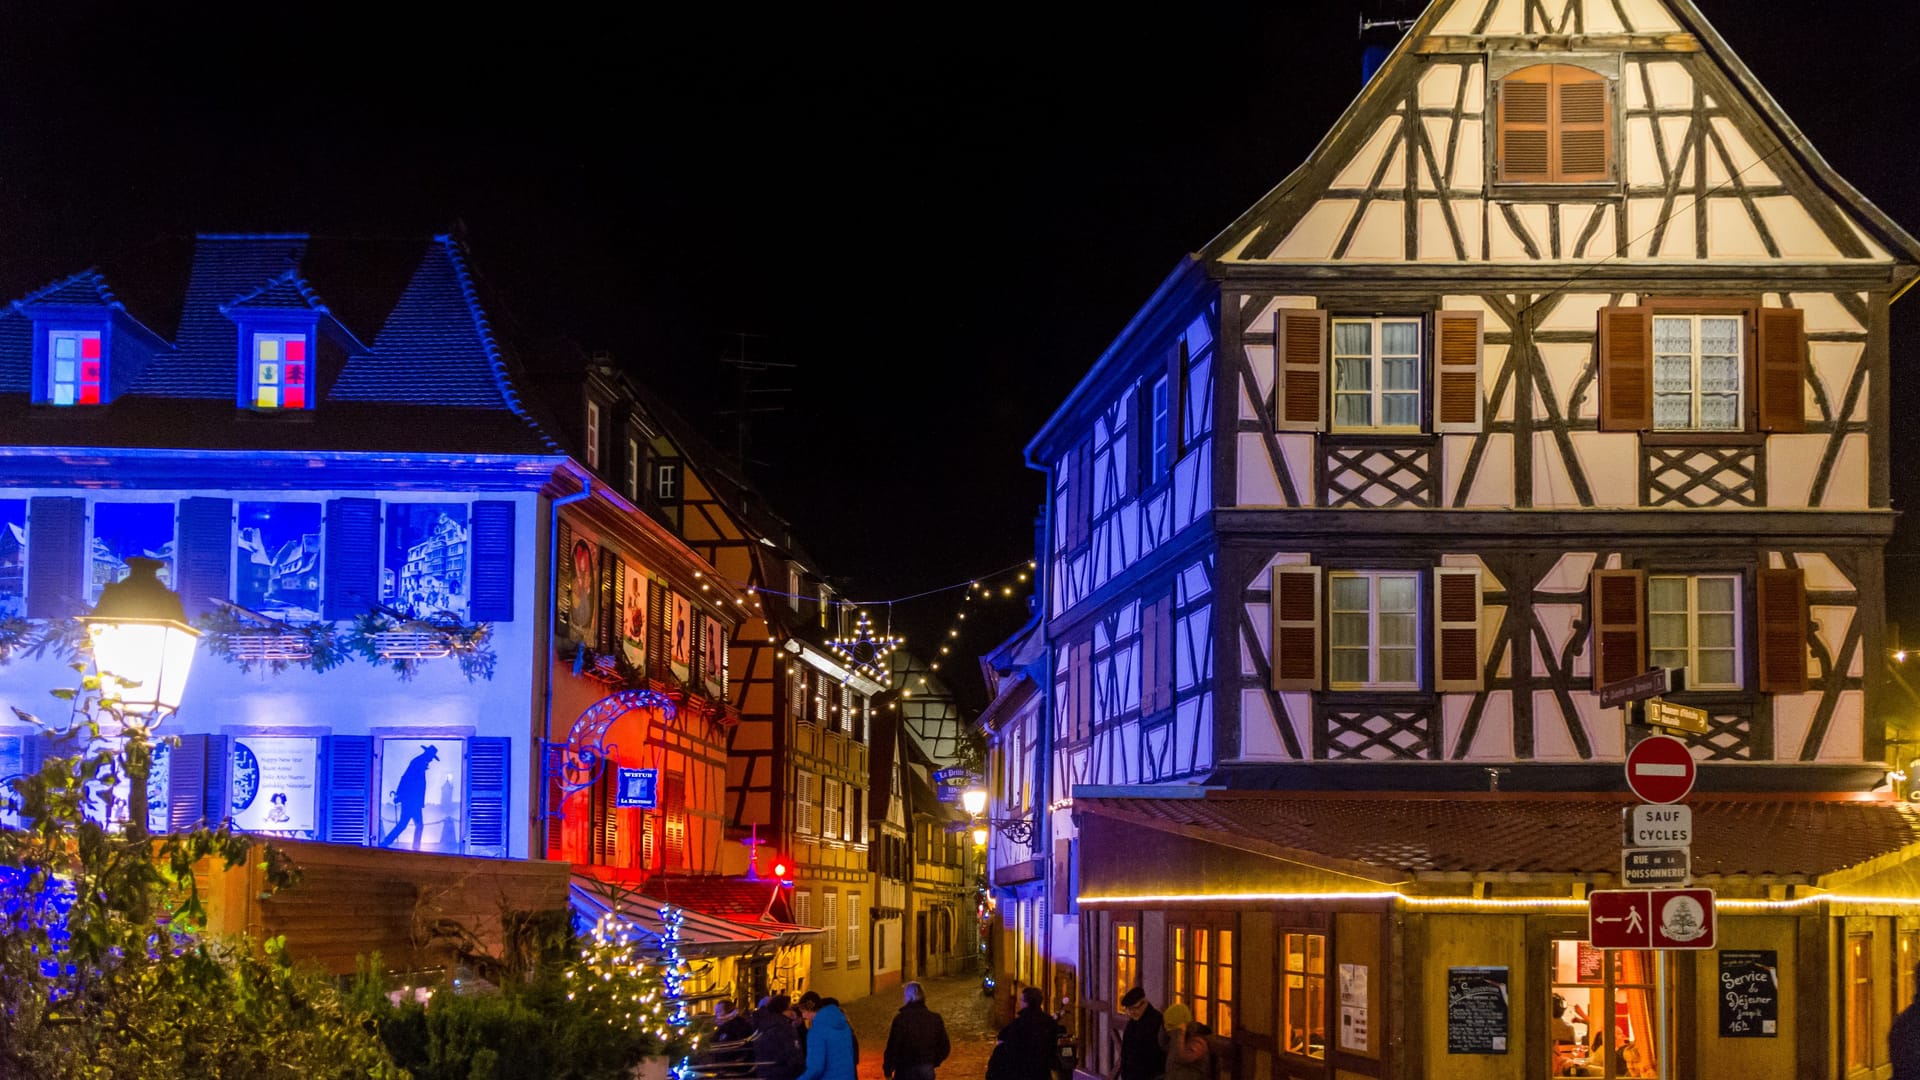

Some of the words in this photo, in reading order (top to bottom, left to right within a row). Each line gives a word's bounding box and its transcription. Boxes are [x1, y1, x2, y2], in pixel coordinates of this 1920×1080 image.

[1646, 811, 1680, 822] SAUF
[1639, 829, 1688, 841] CYCLES
[1633, 855, 1649, 865] RUE
[1626, 867, 1687, 879] POISSONNERIE
[1721, 970, 1768, 990] Service
[1726, 991, 1772, 1010] Déjeuner
